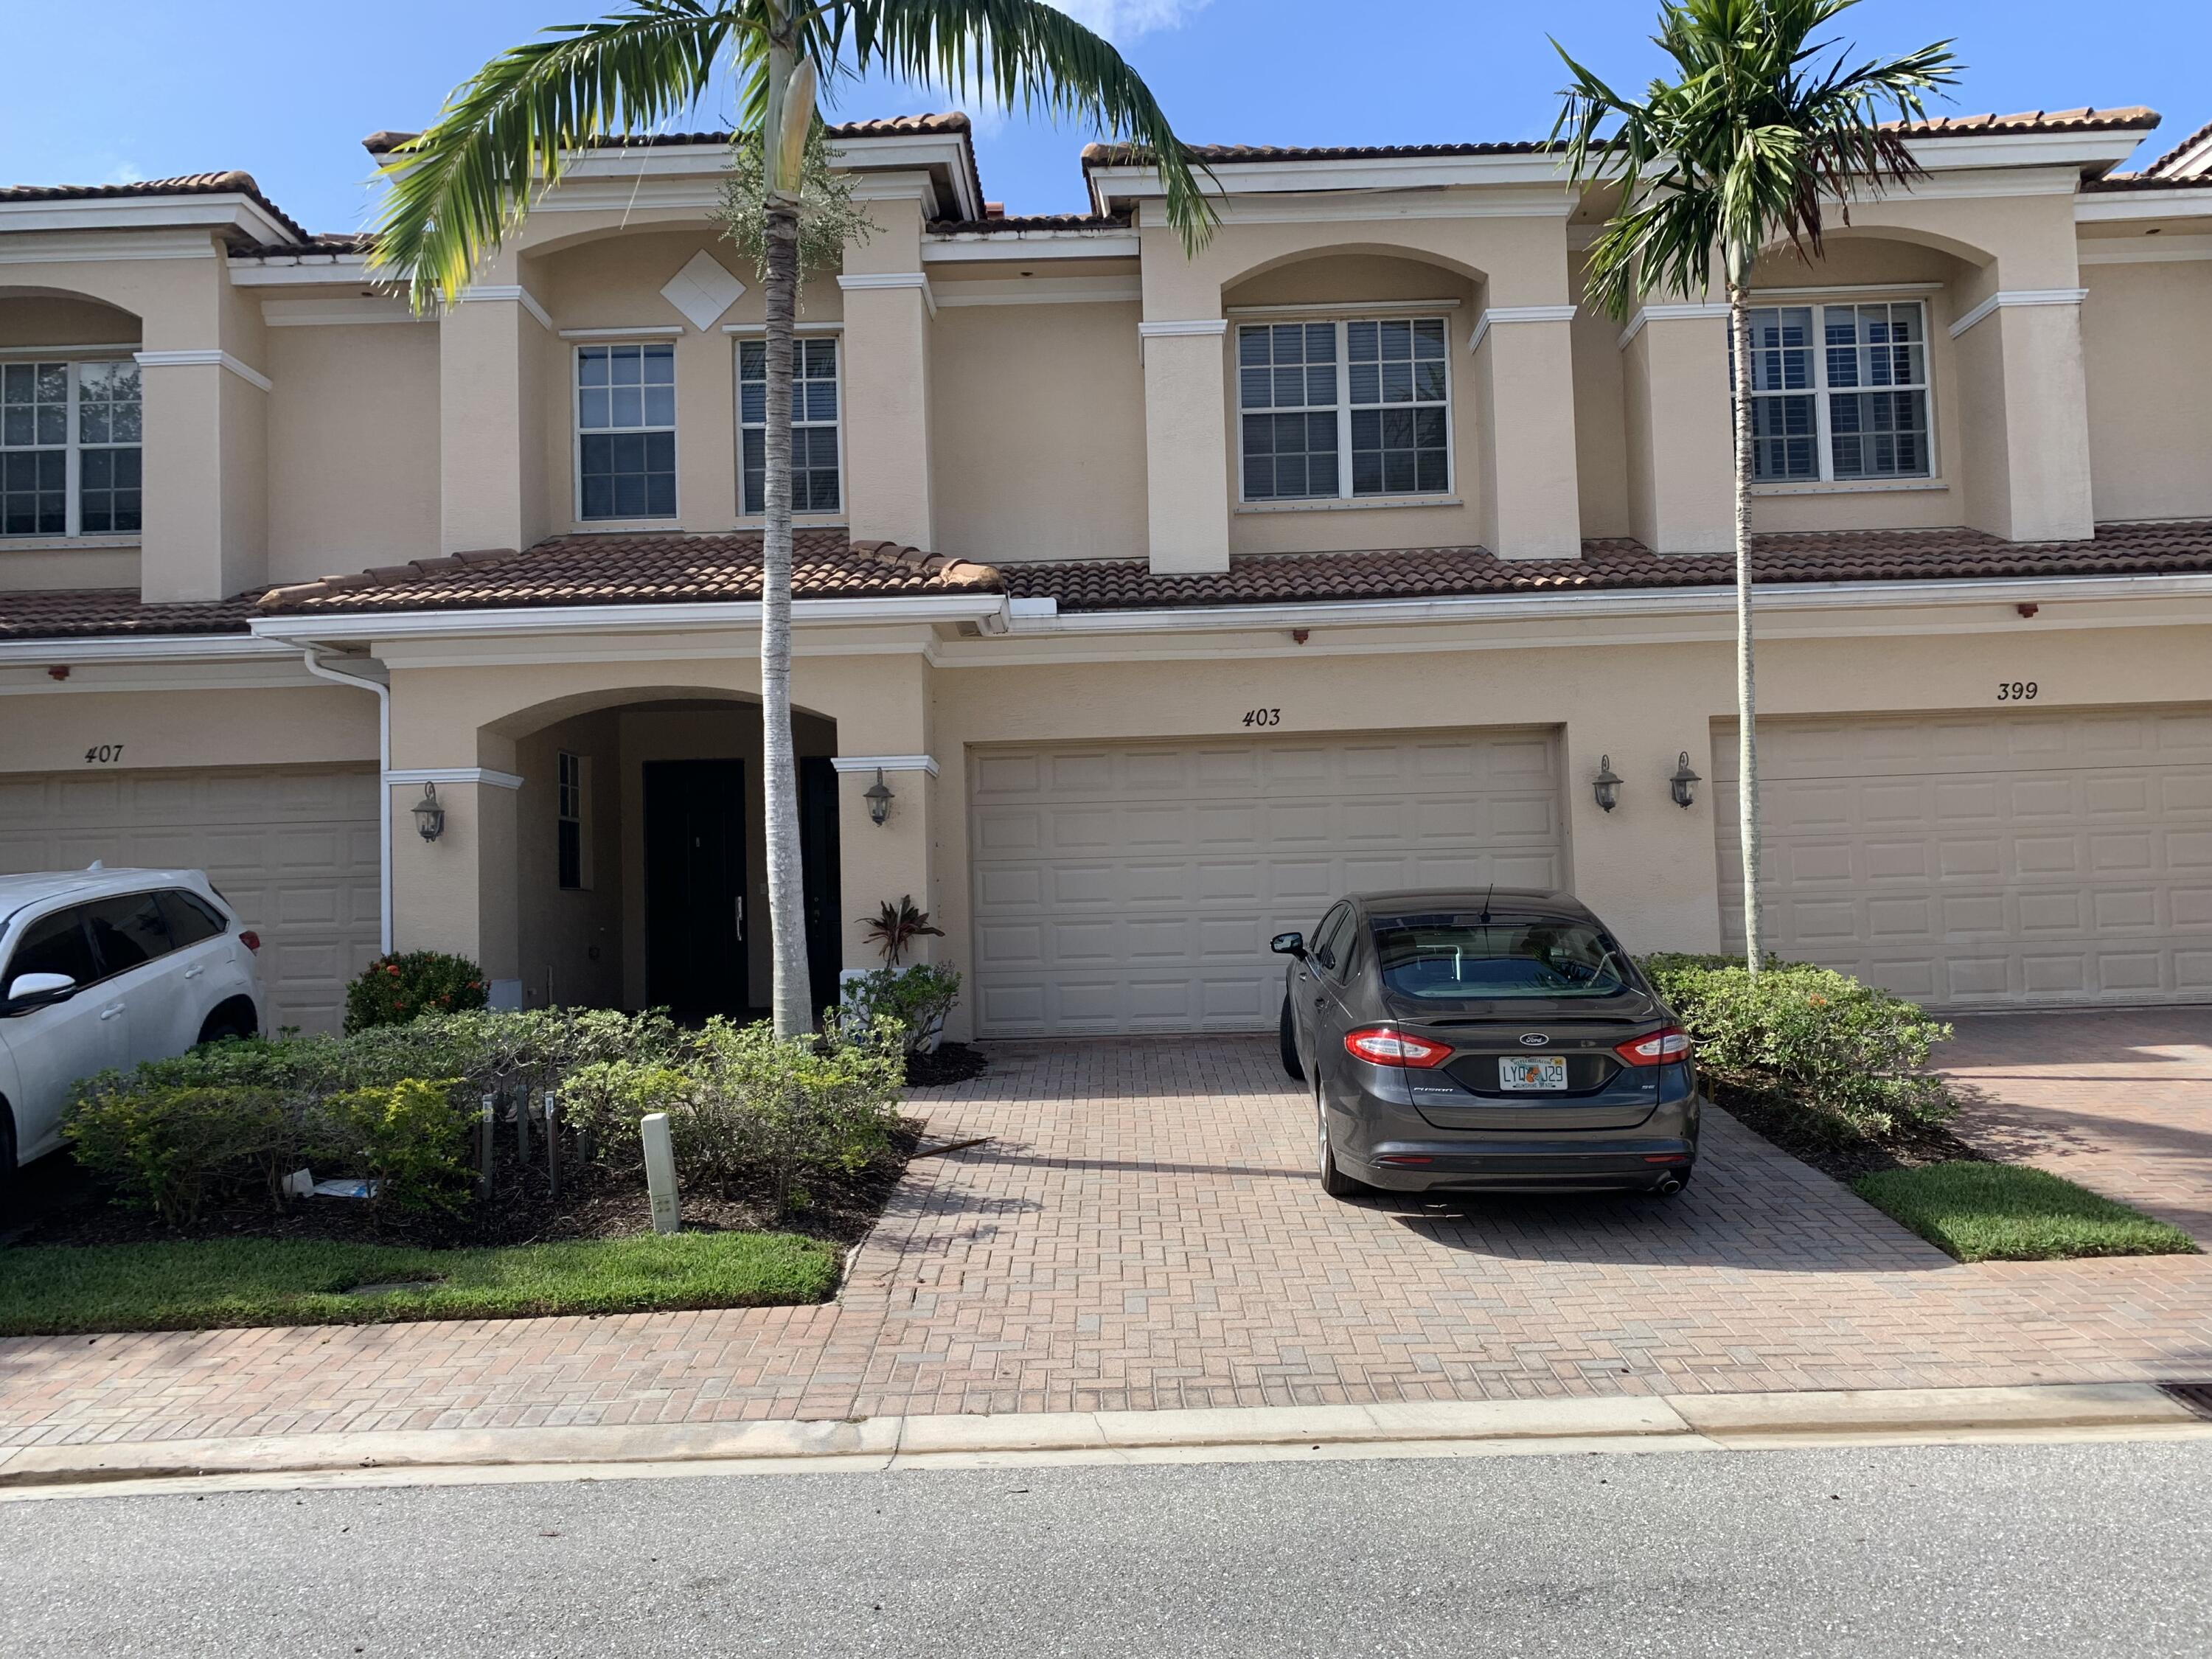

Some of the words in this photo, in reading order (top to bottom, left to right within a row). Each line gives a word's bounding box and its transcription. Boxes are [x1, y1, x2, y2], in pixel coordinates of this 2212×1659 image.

[1997, 681, 2038, 700] 399
[1242, 708, 1281, 727] 403
[84, 745, 125, 764] 407
